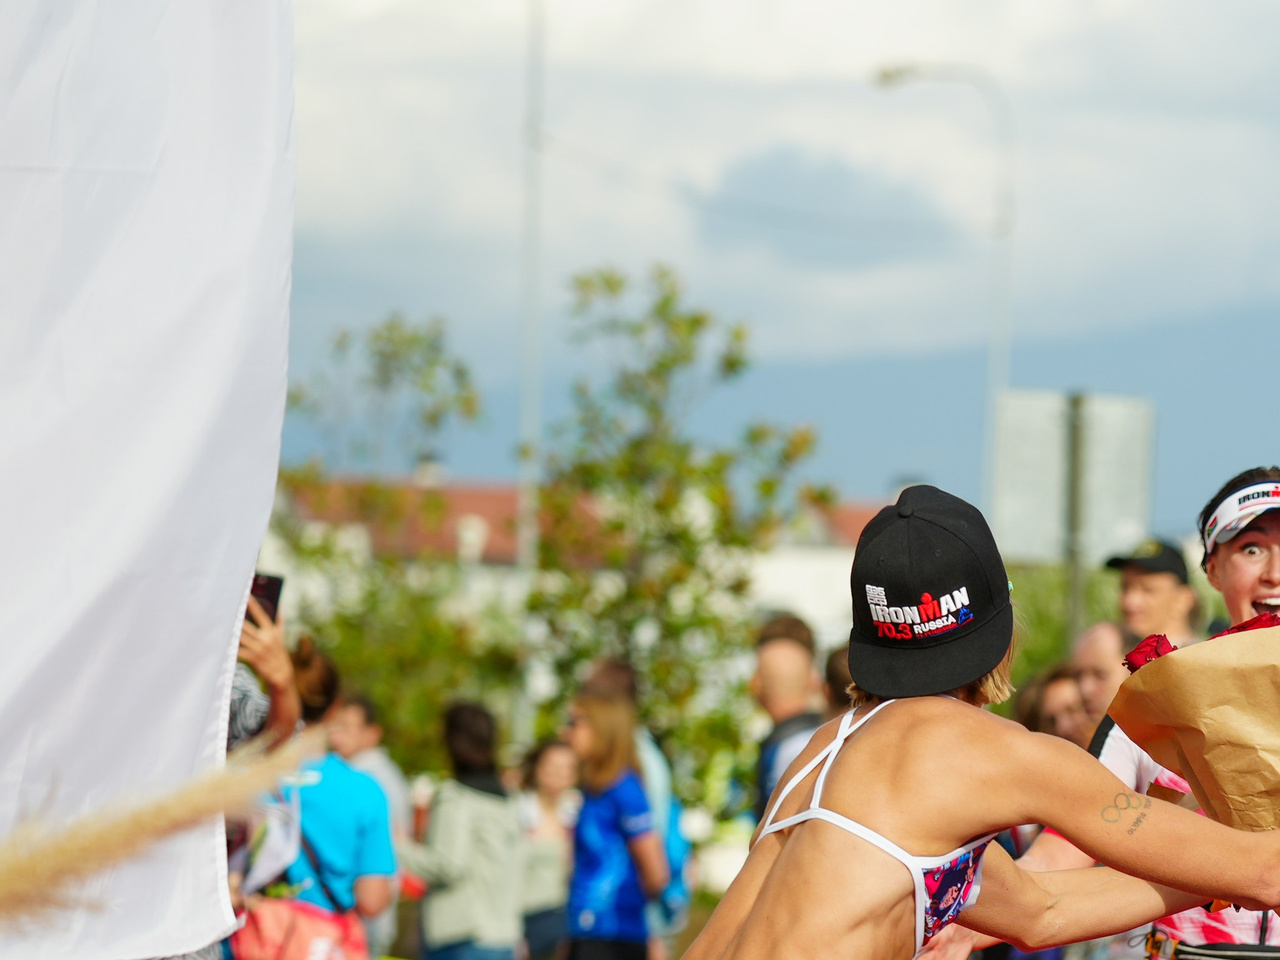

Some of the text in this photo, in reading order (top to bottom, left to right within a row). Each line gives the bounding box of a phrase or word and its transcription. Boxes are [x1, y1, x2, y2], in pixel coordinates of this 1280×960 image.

[869, 586, 970, 624] IRONMAN
[873, 621, 913, 640] 70.3
[913, 613, 957, 634] RUSSIA
